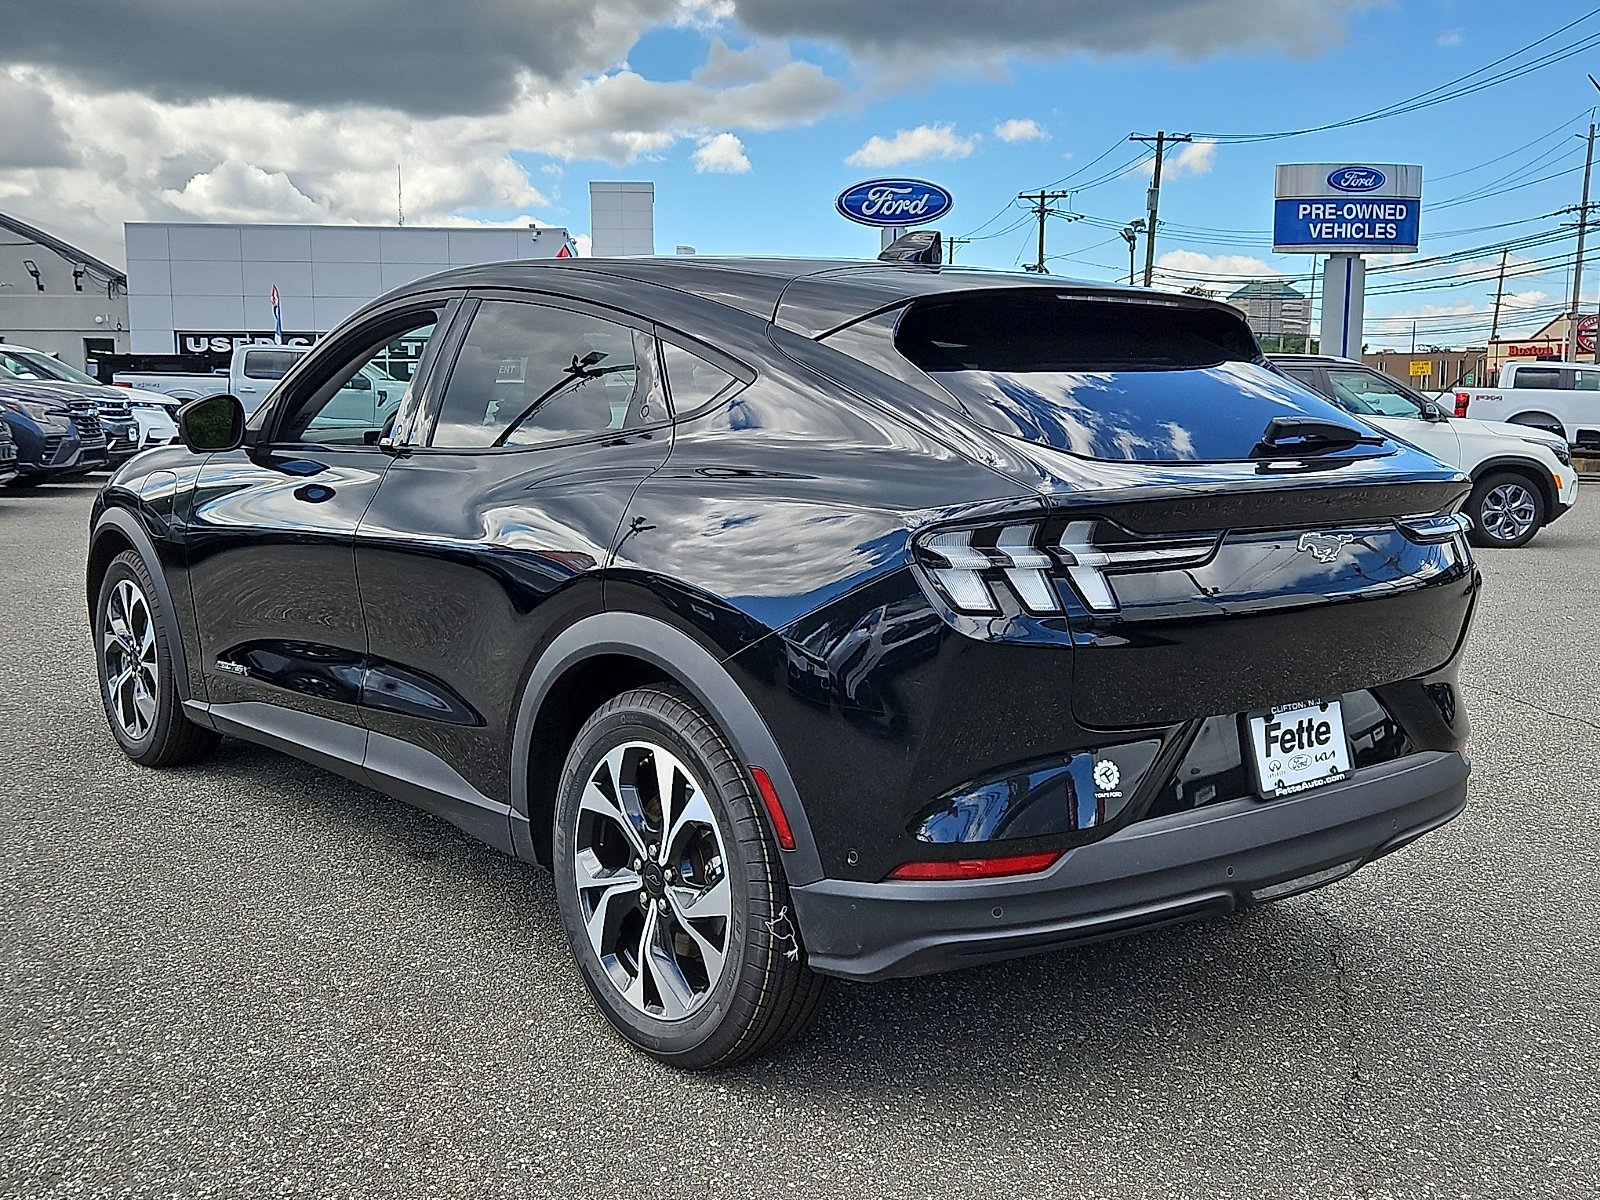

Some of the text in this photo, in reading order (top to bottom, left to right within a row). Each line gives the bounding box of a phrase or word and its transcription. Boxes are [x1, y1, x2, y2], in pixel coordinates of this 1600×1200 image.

[1340, 171, 1375, 187] Ford
[861, 186, 930, 216] Ford
[1298, 203, 1407, 220] PRE-OWNED
[1308, 222, 1397, 239] VEHICLES
[1508, 345, 1553, 356] Boston
[1265, 718, 1331, 758] Fette
[1275, 773, 1346, 797] FetteAuto.com
